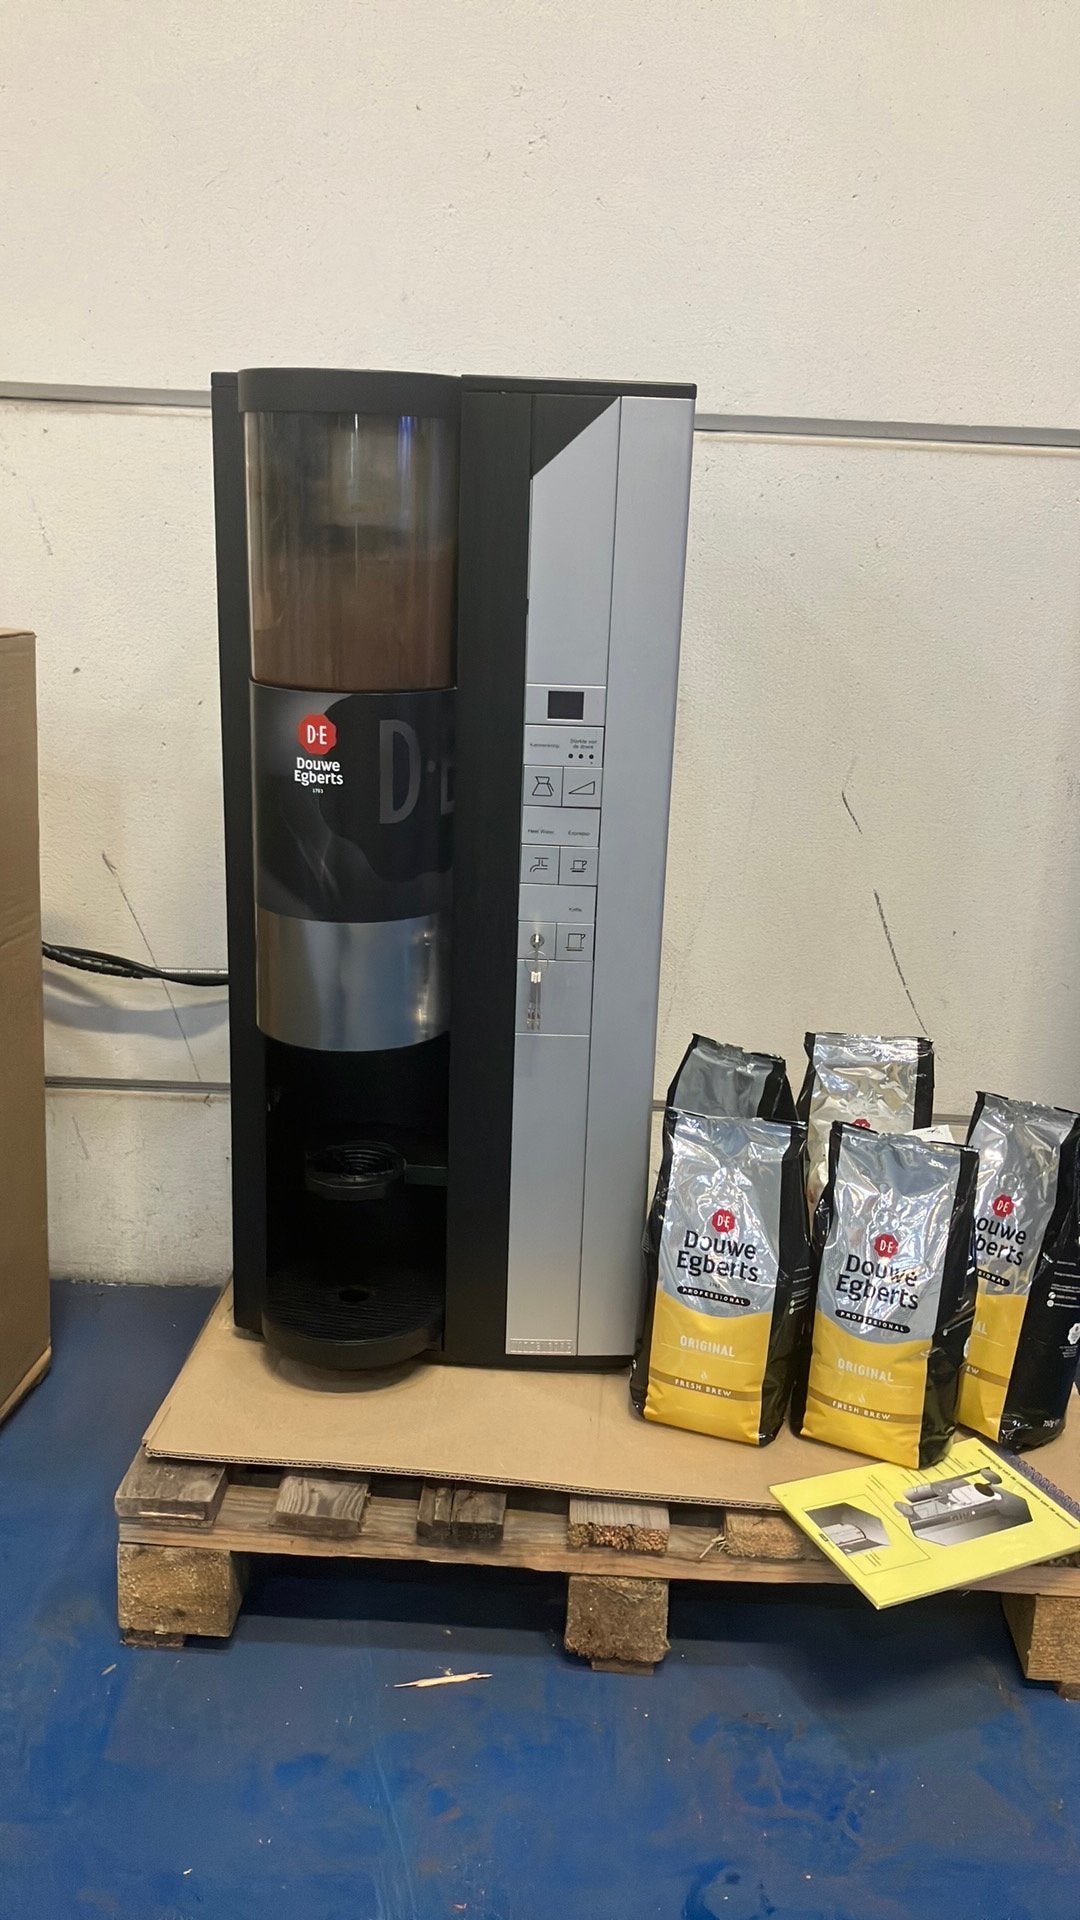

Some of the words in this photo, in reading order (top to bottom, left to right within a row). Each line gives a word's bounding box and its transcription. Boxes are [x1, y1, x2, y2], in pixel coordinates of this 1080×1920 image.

[296, 756, 341, 772] Douwe
[294, 769, 344, 787] Egberts
[976, 1217, 1027, 1245] ouwe
[684, 1229, 757, 1260] Douwe
[976, 1233, 1024, 1266] berts
[676, 1250, 759, 1283] Egberts
[845, 1254, 918, 1287] Douwe
[682, 1287, 745, 1305] PROFESSIONAL
[836, 1274, 919, 1310] Egberts
[840, 1311, 905, 1332] PROFSSIONAL
[680, 1335, 736, 1357] ORIGINAL
[837, 1358, 894, 1382] ORIGINAL
[675, 1378, 702, 1391] FRESH
[705, 1386, 732, 1397] BREW
[832, 1400, 860, 1414] FRESH
[863, 1409, 891, 1420] BREW
